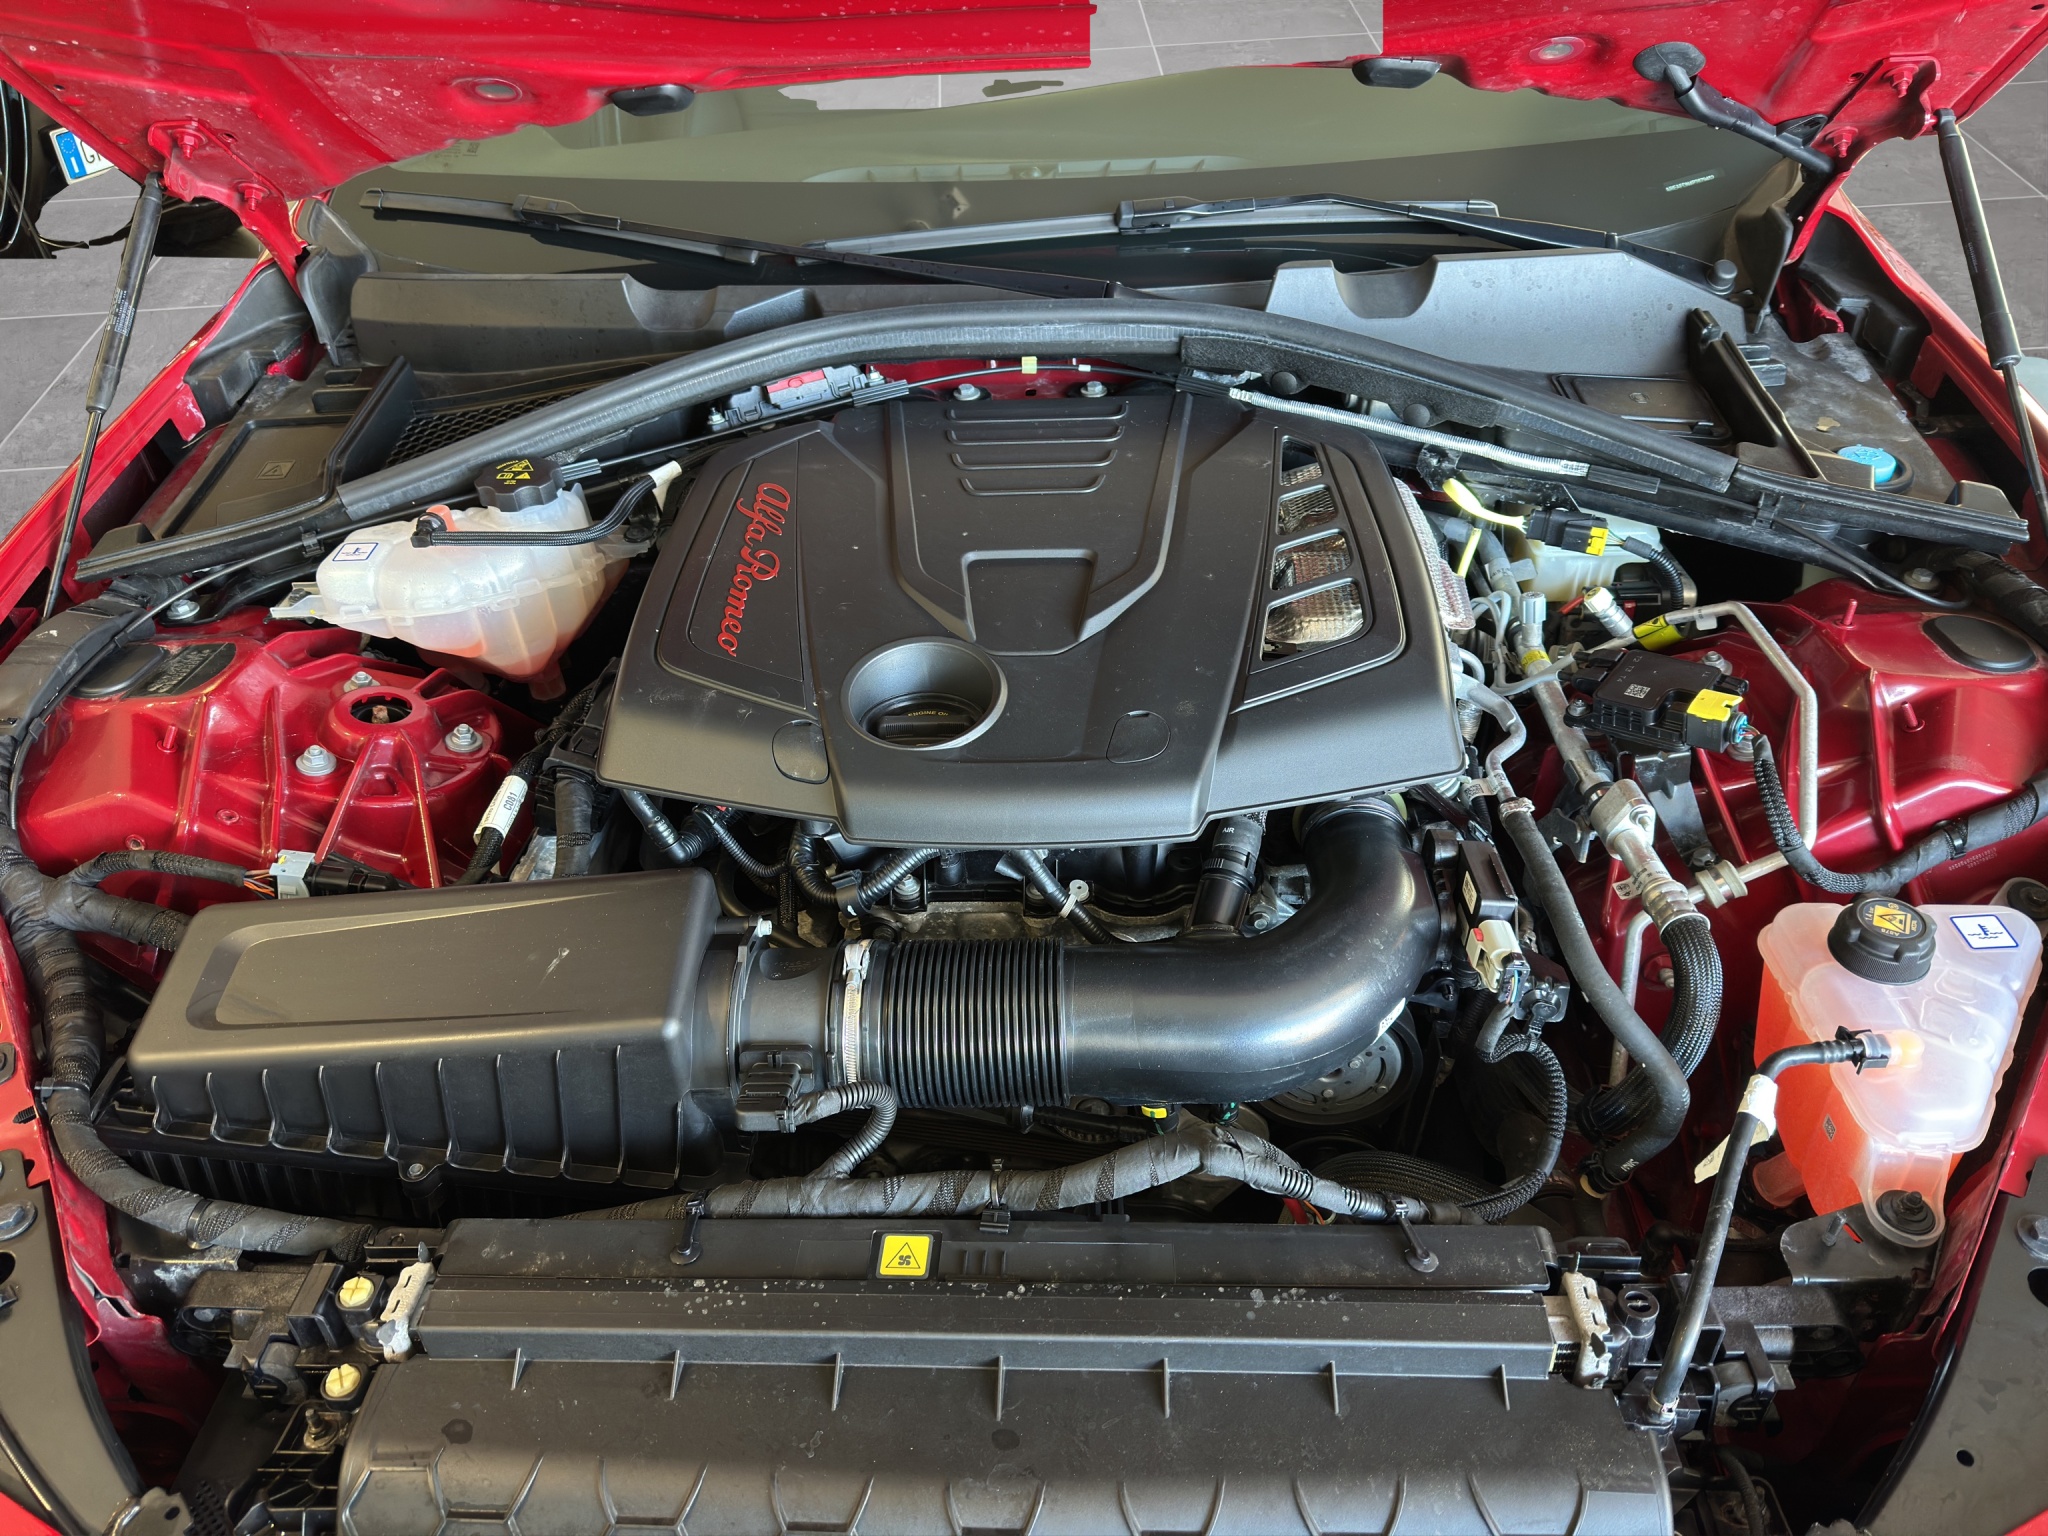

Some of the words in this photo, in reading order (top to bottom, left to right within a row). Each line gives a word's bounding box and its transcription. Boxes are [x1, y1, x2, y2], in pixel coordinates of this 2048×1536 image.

[80, 140, 101, 163] G
[736, 482, 790, 547] Alfa
[717, 545, 780, 657] Romeo
[1222, 826, 1235, 834] AIR
